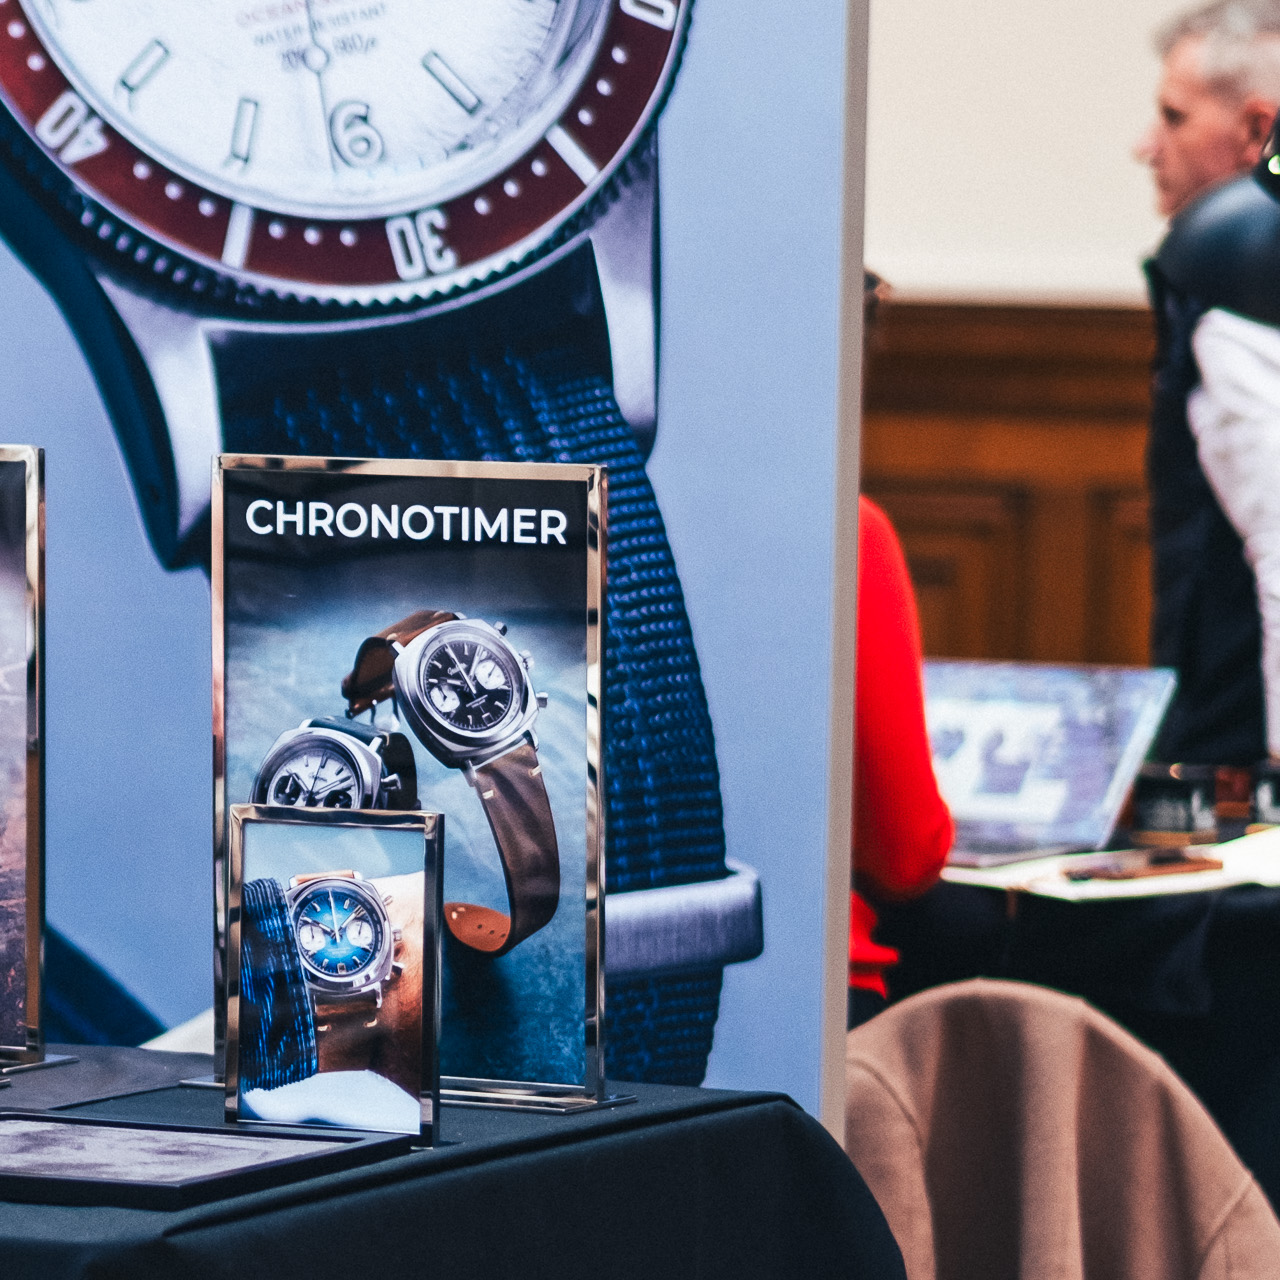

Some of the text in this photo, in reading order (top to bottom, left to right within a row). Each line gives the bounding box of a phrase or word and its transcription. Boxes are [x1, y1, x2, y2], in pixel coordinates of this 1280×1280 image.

[35, 90, 108, 164] 40
[329, 99, 385, 168] 6
[385, 209, 457, 281] 30
[245, 498, 568, 545] CHRONOTIMER
